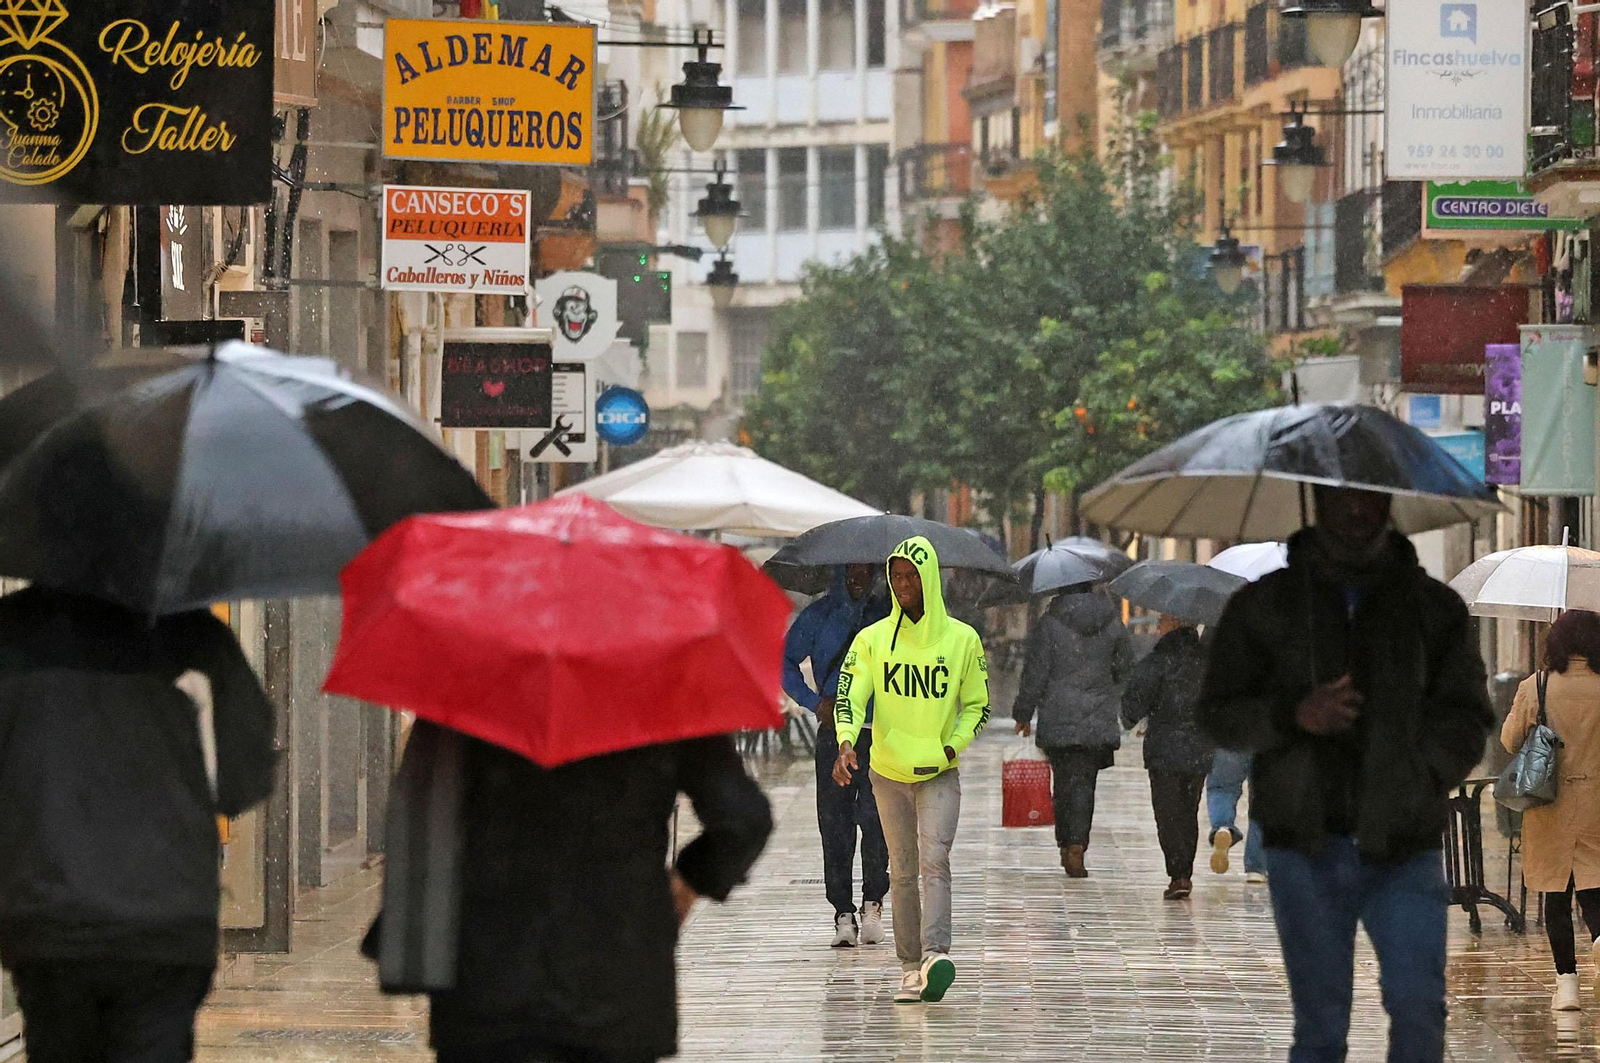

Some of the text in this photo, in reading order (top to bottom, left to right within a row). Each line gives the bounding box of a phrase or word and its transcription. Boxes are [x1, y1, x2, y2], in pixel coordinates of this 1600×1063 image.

[99, 18, 262, 91] Relojería
[395, 33, 586, 91] ALDEMAR
[1393, 49, 1522, 67] Fincashuelva
[447, 96, 516, 106] BARBER SHOP
[1411, 104, 1503, 120] Inmobiliaria
[1, 127, 62, 149] Juanma
[121, 103, 237, 154] Taller
[393, 107, 582, 150] PELUQUEROS
[1407, 145, 1433, 158] 959
[1486, 145, 1504, 158] 00
[1441, 200, 1501, 215] CENTRO
[390, 218, 524, 238] PELUQUERIA
[387, 266, 525, 289] Caballeros y Niños
[597, 413, 646, 424] DIGI
[884, 662, 949, 699] KING
